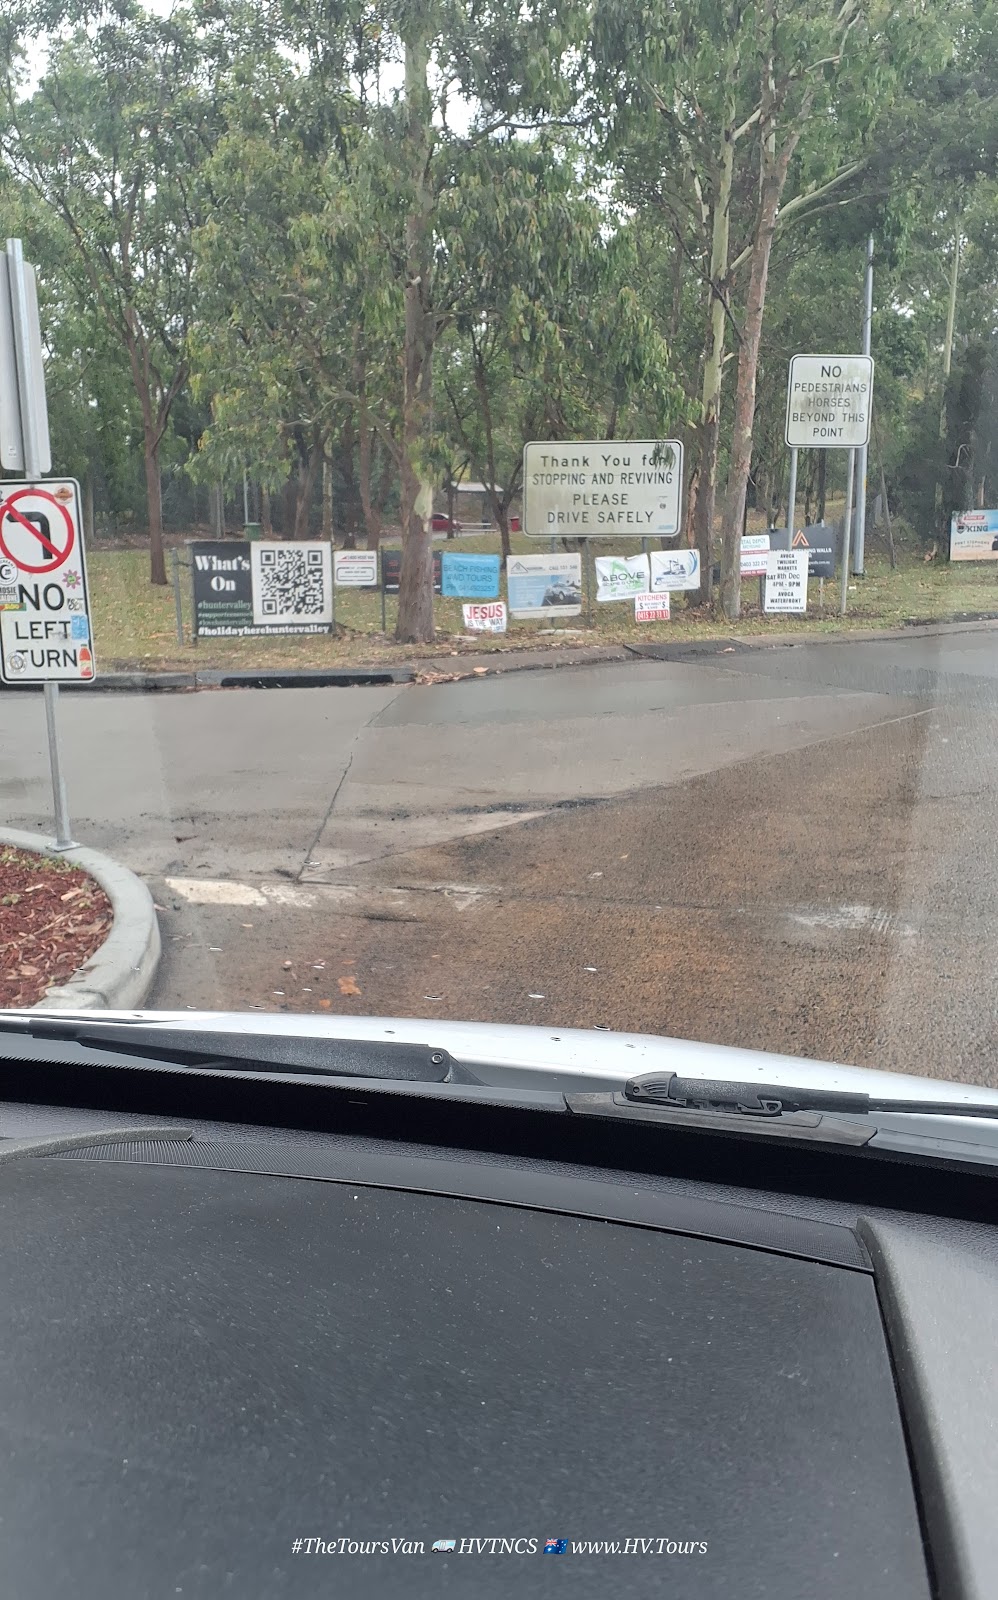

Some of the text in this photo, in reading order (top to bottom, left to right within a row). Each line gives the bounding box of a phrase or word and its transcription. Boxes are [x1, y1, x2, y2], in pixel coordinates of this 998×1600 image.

[820, 366, 842, 378] NO
[794, 382, 867, 392] PEDESTRIANS
[808, 398, 851, 407] HORSES
[792, 413, 865, 422] BEYOND THIS
[813, 428, 844, 437] POINT
[540, 454, 665, 467] Thank You for
[532, 472, 673, 485] STOPPING AND REVIVING
[572, 493, 629, 505] PLEASE
[547, 511, 654, 523] DRIVE SAFELY
[195, 555, 250, 571] What's
[602, 571, 645, 582] ABOVE
[211, 576, 236, 591] On
[18, 584, 64, 611] NO
[198, 600, 252, 610] #huntervalley
[467, 604, 503, 619] JESUS
[15, 621, 71, 640] LEFT
[198, 625, 330, 636] #holidayherehuntervalley
